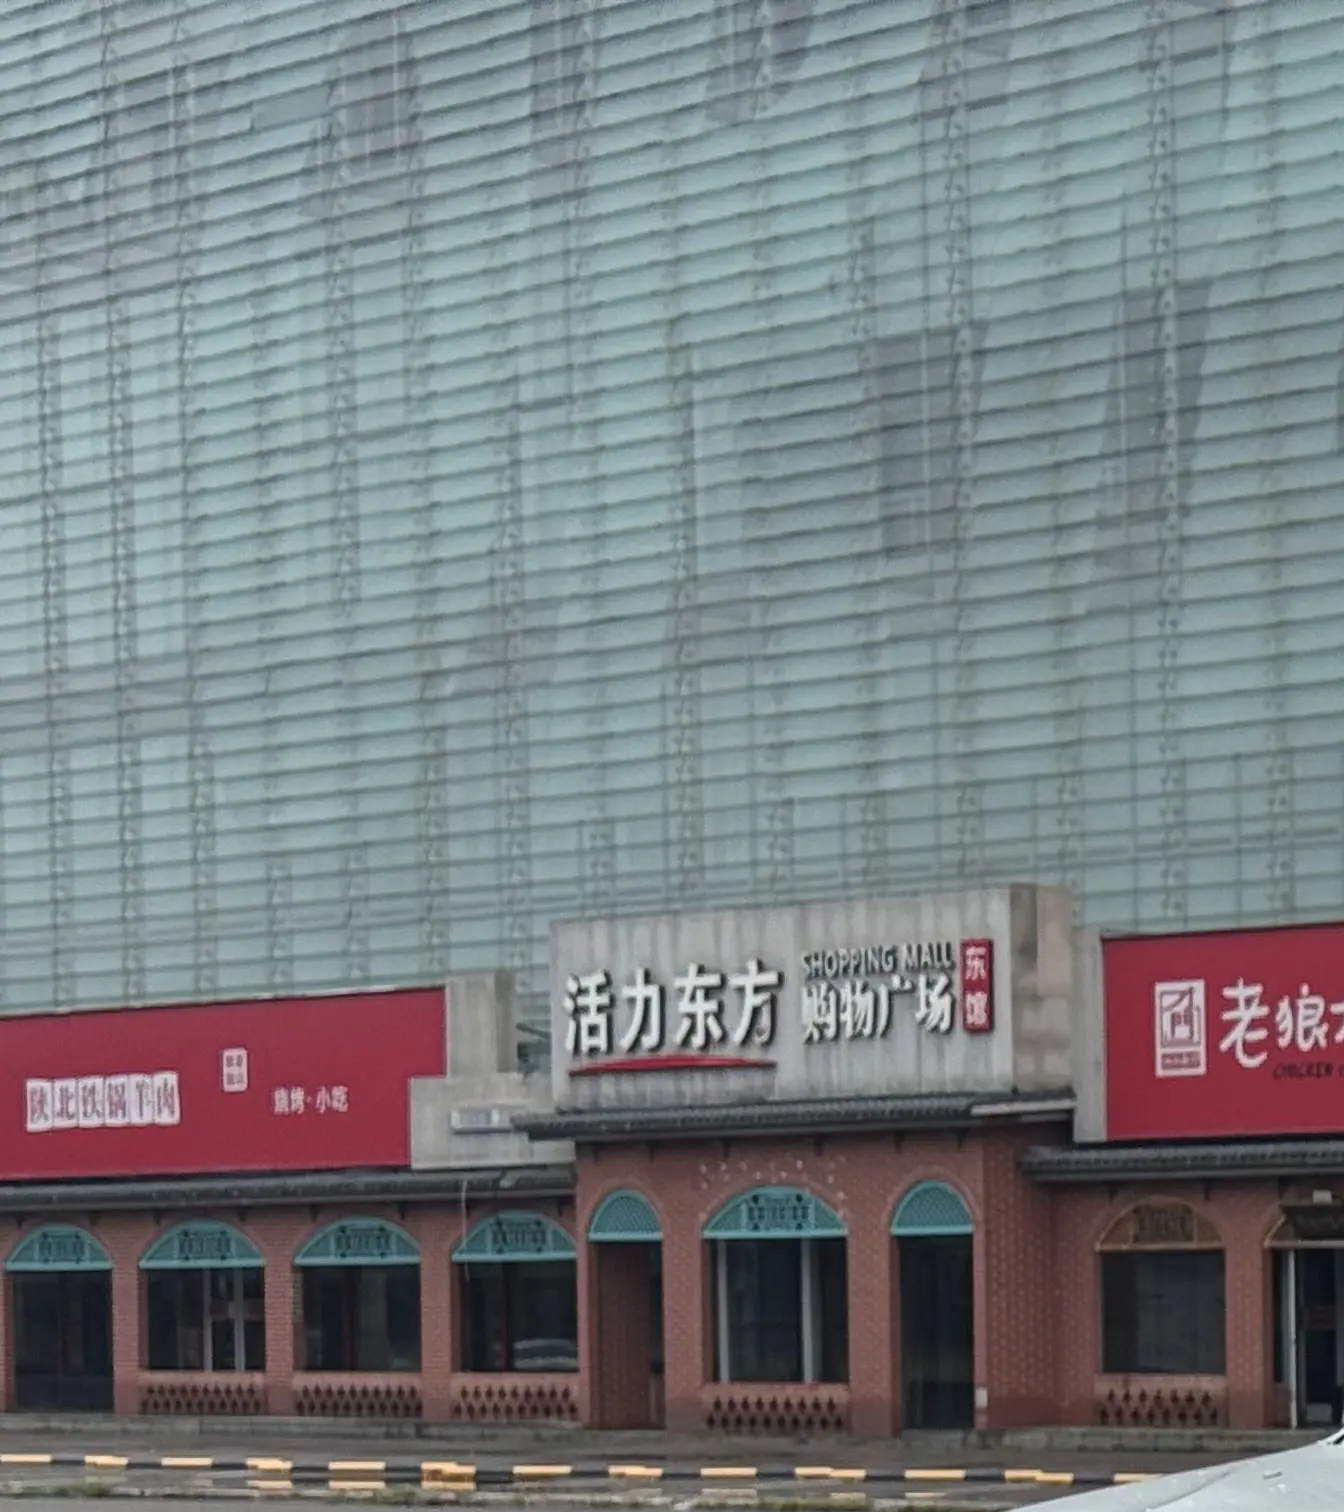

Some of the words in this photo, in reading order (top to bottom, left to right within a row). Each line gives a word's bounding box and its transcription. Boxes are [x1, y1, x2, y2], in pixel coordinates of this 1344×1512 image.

[802, 944, 896, 978] SHOPPING
[902, 941, 955, 970] MALL
[563, 957, 780, 1052] 活力东方
[801, 973, 953, 1042] 购物广场
